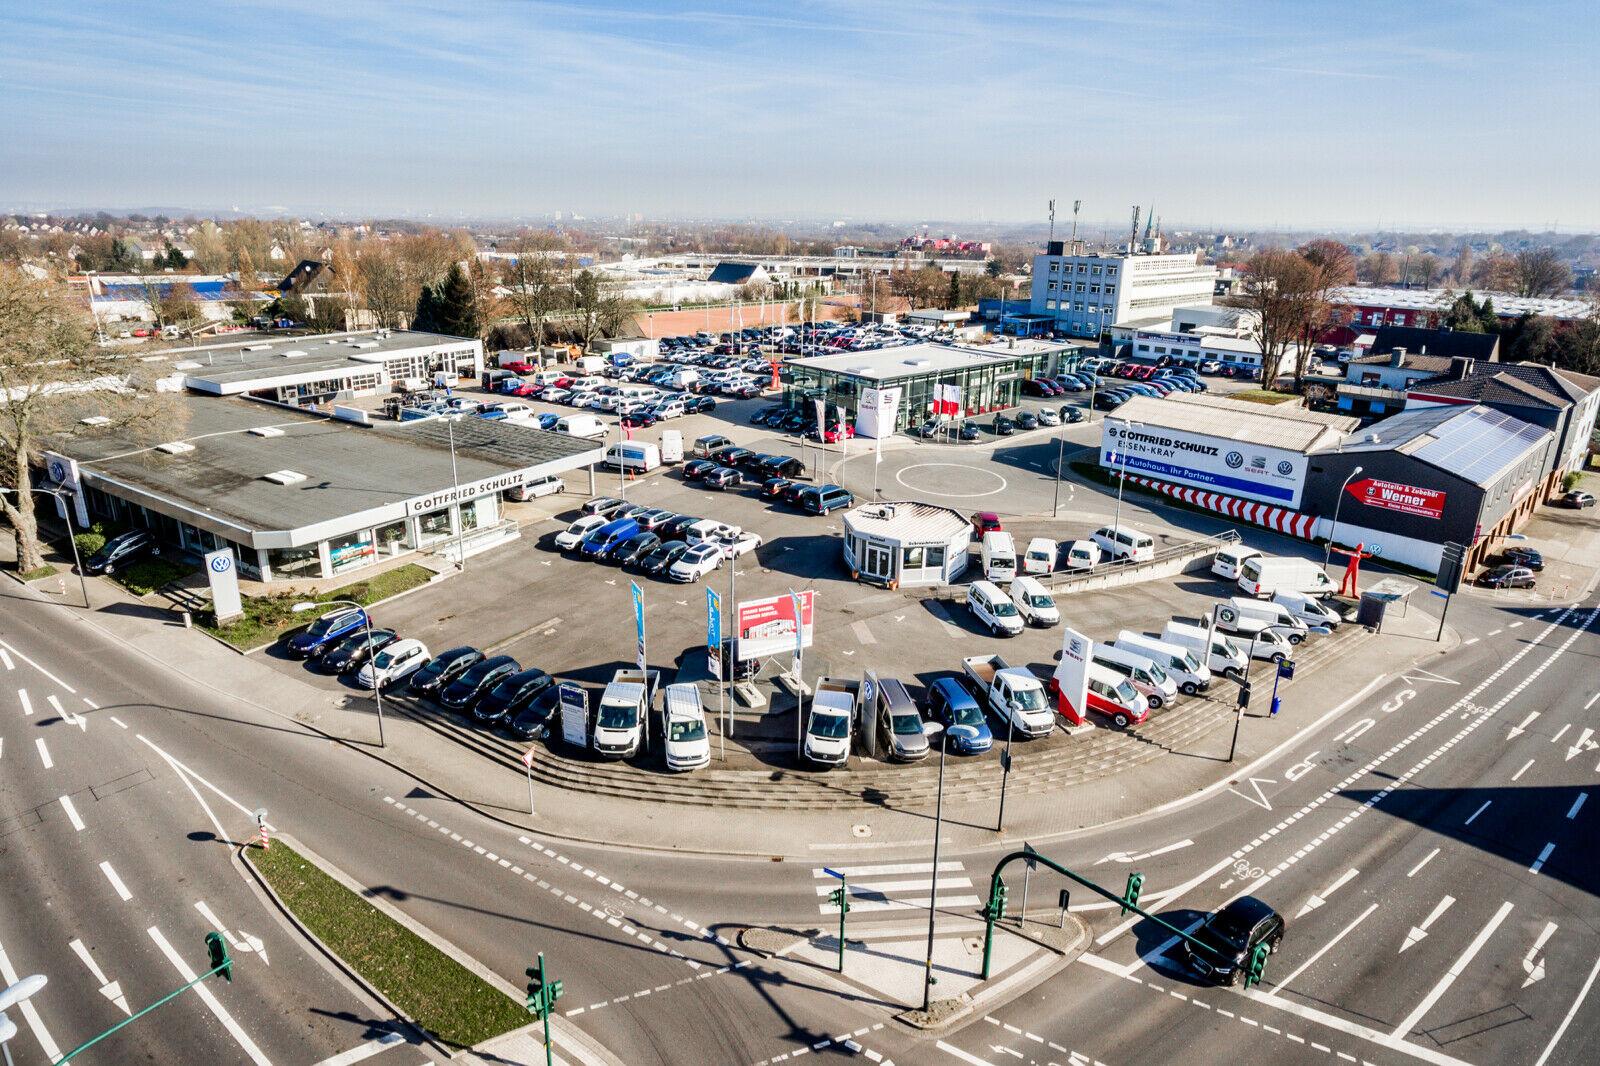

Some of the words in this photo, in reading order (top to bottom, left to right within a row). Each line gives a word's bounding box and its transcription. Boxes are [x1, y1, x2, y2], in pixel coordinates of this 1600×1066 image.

[1117, 440, 1175, 458] ESSEN-KRAY
[1119, 430, 1172, 447] GOTTFRIED
[1173, 440, 1219, 456] SCHULTZ
[1128, 457, 1168, 472] Autohaus.
[1170, 467, 1182, 476] Ihr
[1183, 469, 1216, 483] Partner.
[1244, 466, 1270, 475] SEAT
[414, 488, 475, 510] GOTTFRIED
[480, 474, 523, 493] SCHULTZ
[1373, 480, 1403, 491] Autoteile
[1411, 486, 1439, 498] Zubehör
[1381, 489, 1426, 506] Werner
